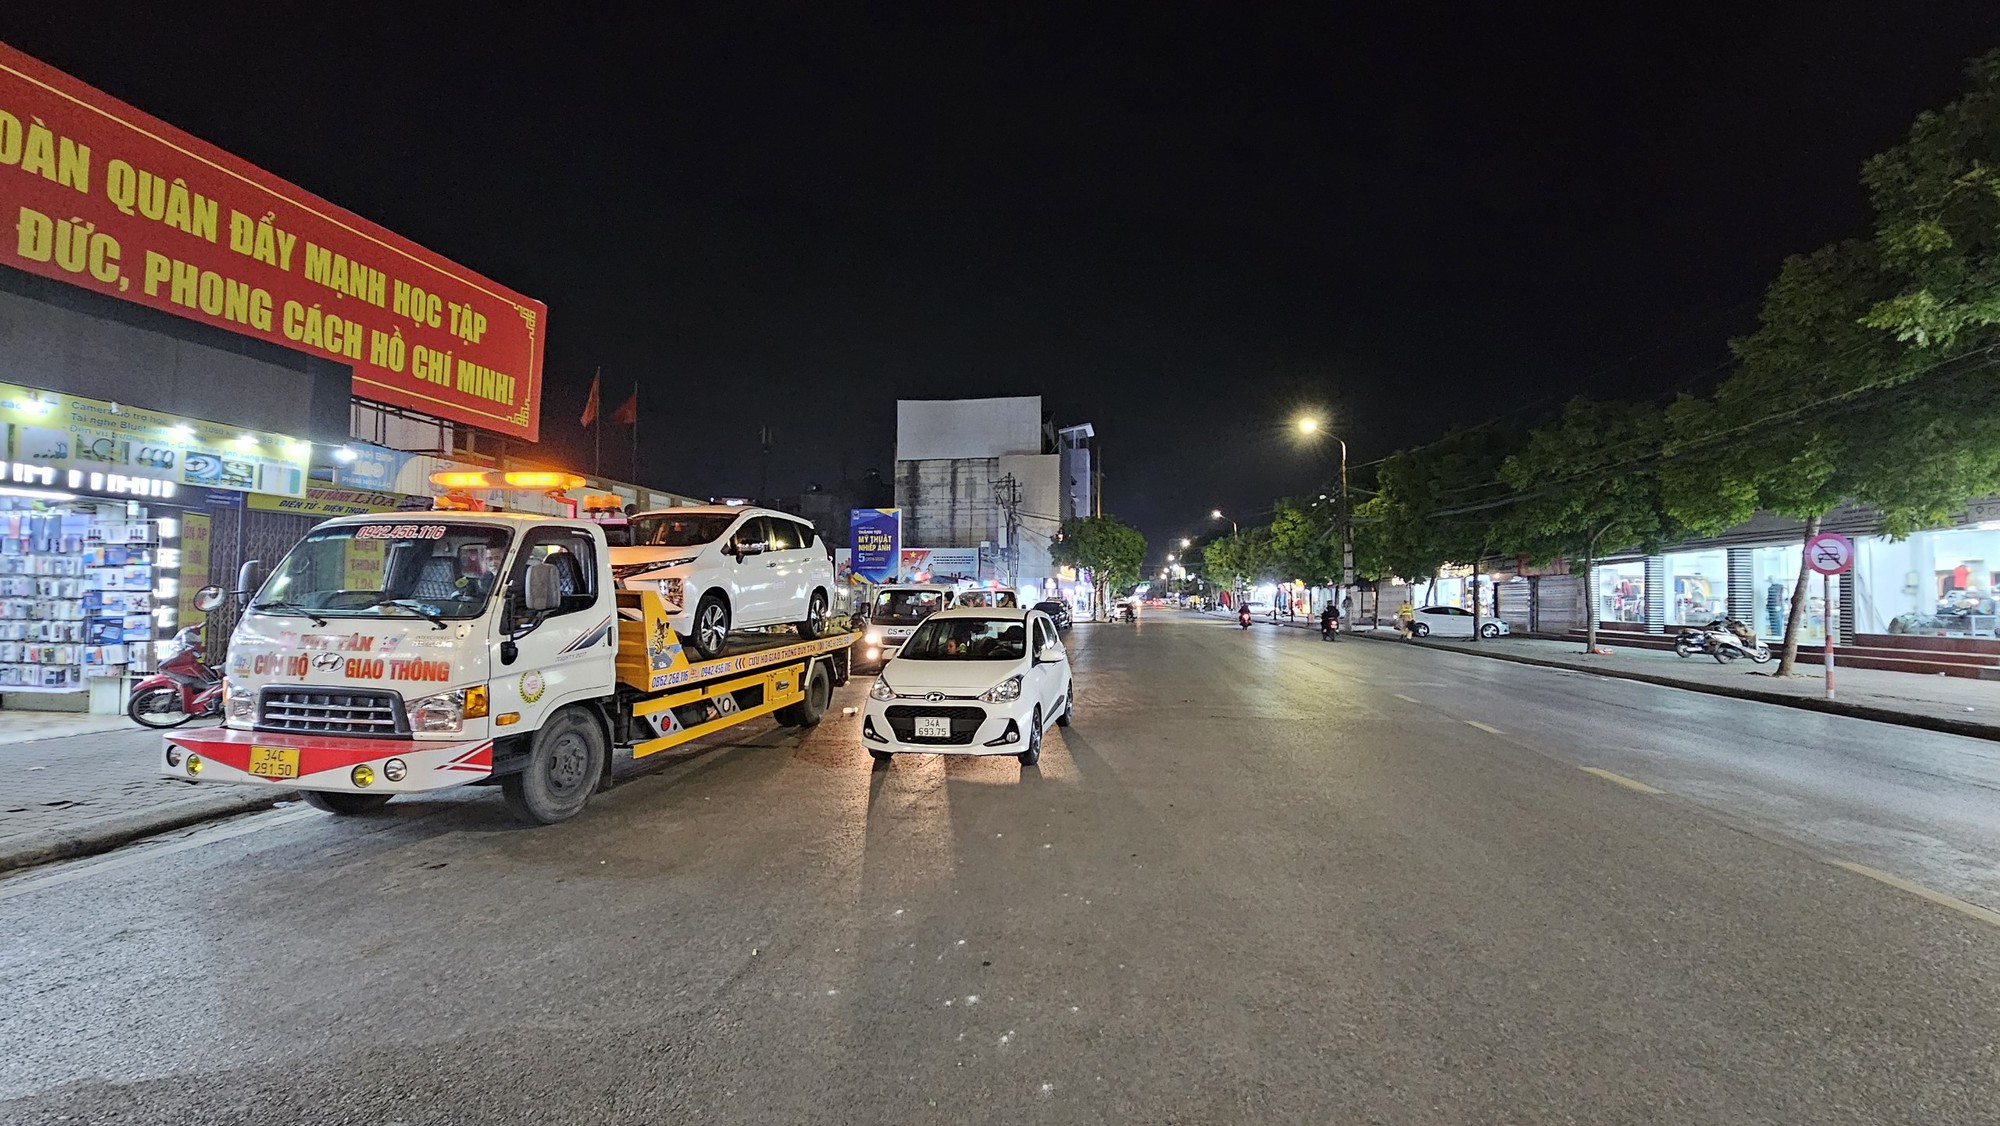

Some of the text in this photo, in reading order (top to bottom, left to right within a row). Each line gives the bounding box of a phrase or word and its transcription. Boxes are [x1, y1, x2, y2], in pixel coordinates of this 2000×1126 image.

[106, 159, 218, 244] QUÂN
[230, 210, 296, 272] ĐẨY
[305, 242, 386, 308] MẠNH
[394, 278, 442, 328] HỌC
[448, 302, 486, 345] TẬP
[16, 207, 515, 406] ĐỨC, PHONG CÁCH HỒ CHÍ MINH!
[71, 412, 87, 421] Tai
[90, 417, 117, 428] nghe
[355, 525, 446, 539] 0942.456.116
[858, 533, 892, 544] MỸ THUẬT
[858, 542, 876, 551] NHIẾP
[858, 553, 865, 562] 5
[337, 632, 374, 651] TÂN
[254, 650, 284, 676] CỨU
[287, 652, 308, 680] HỘ
[345, 658, 384, 680] GIAO
[390, 656, 450, 682] THÔNG
[924, 719, 940, 727] 34A
[918, 728, 947, 736] 693.75
[264, 749, 285, 761] 34C
[254, 762, 292, 776] 291.50
